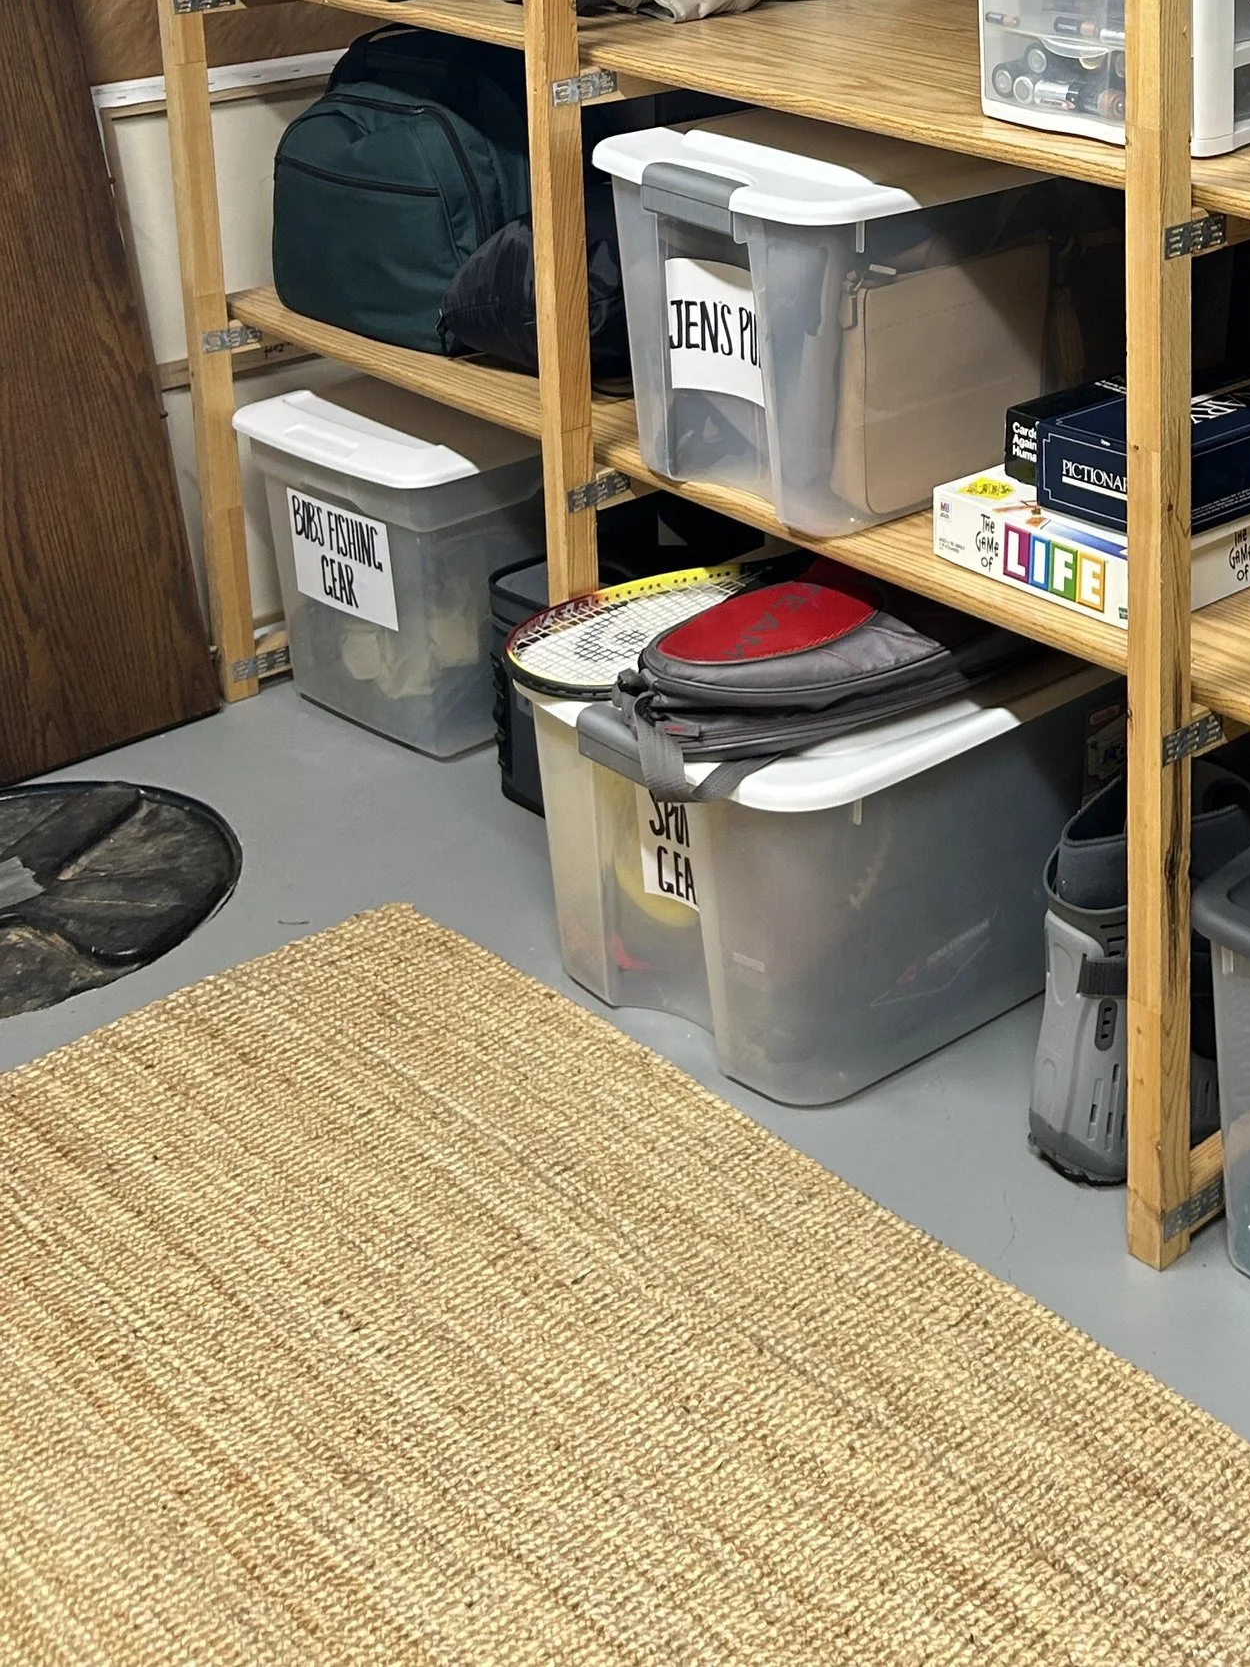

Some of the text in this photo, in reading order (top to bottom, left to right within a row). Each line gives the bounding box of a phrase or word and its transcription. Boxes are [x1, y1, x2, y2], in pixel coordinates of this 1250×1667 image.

[739, 306, 762, 369] PU
[1012, 433, 1037, 451] Again
[1012, 444, 1037, 463] Huma
[1062, 459, 1128, 493] PICTIONA
[327, 510, 383, 572] FISHING
[1004, 523, 1105, 612] LIFE
[321, 554, 359, 609] GEAR
[657, 845, 697, 905] GEA
